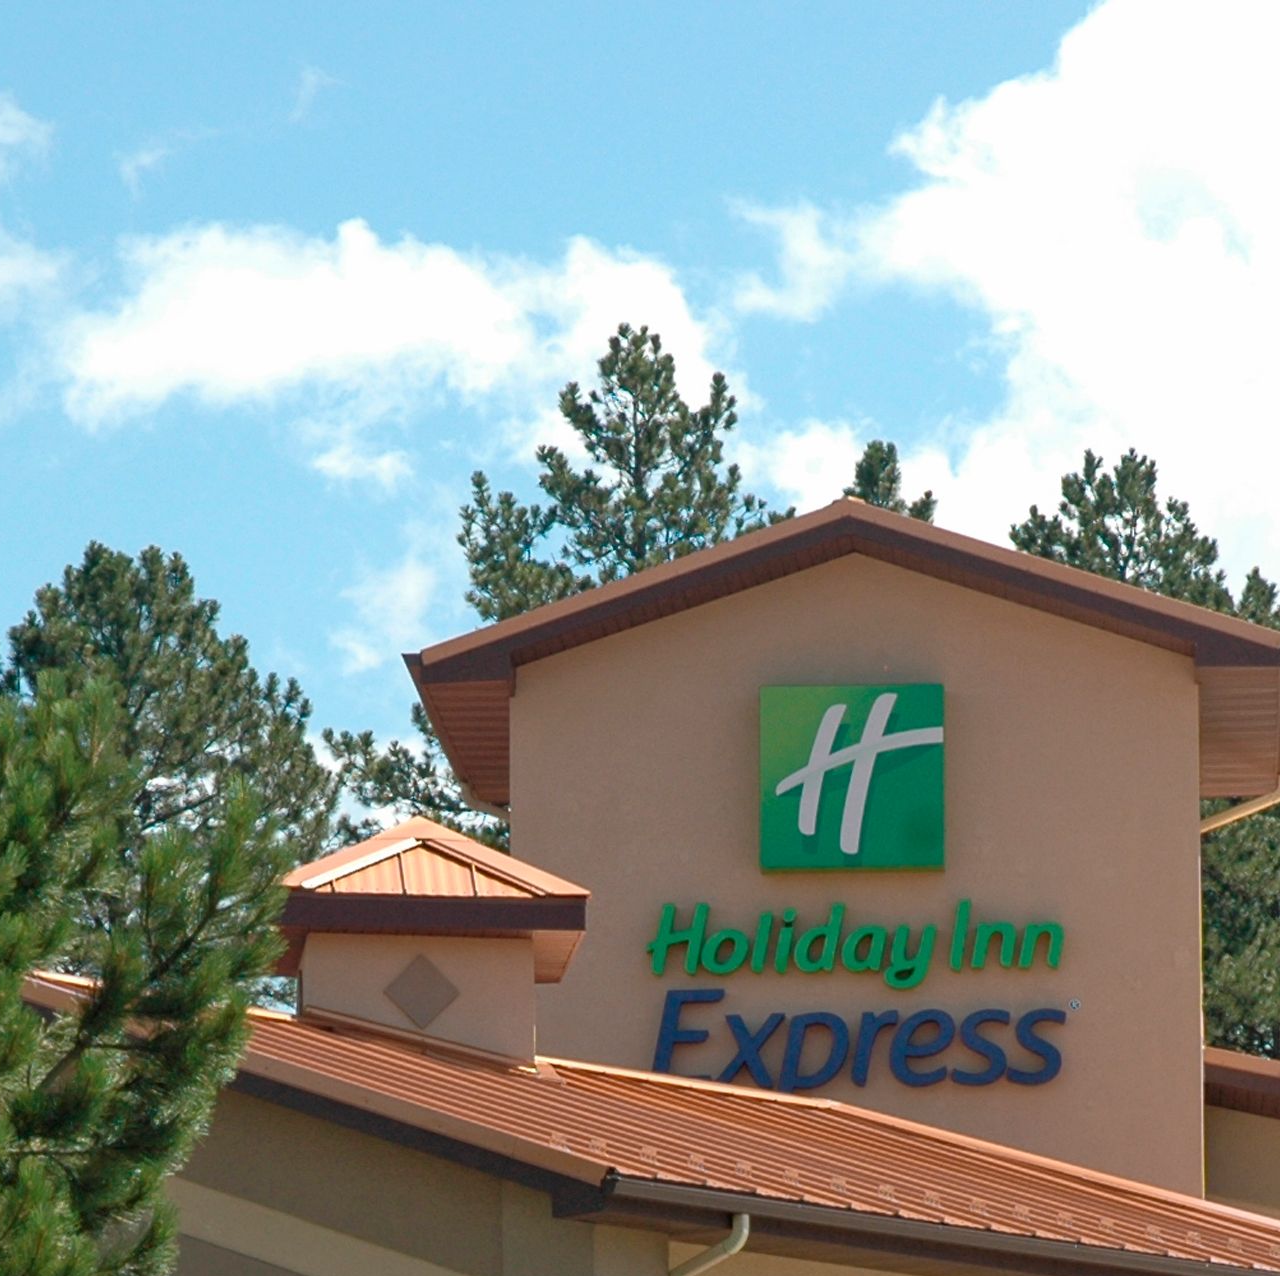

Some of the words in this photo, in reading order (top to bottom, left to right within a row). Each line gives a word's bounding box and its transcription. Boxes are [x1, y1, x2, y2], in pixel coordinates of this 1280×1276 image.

[646, 902, 937, 990] Holiday
[949, 899, 1065, 973] Inn
[651, 988, 1067, 1092] Express
